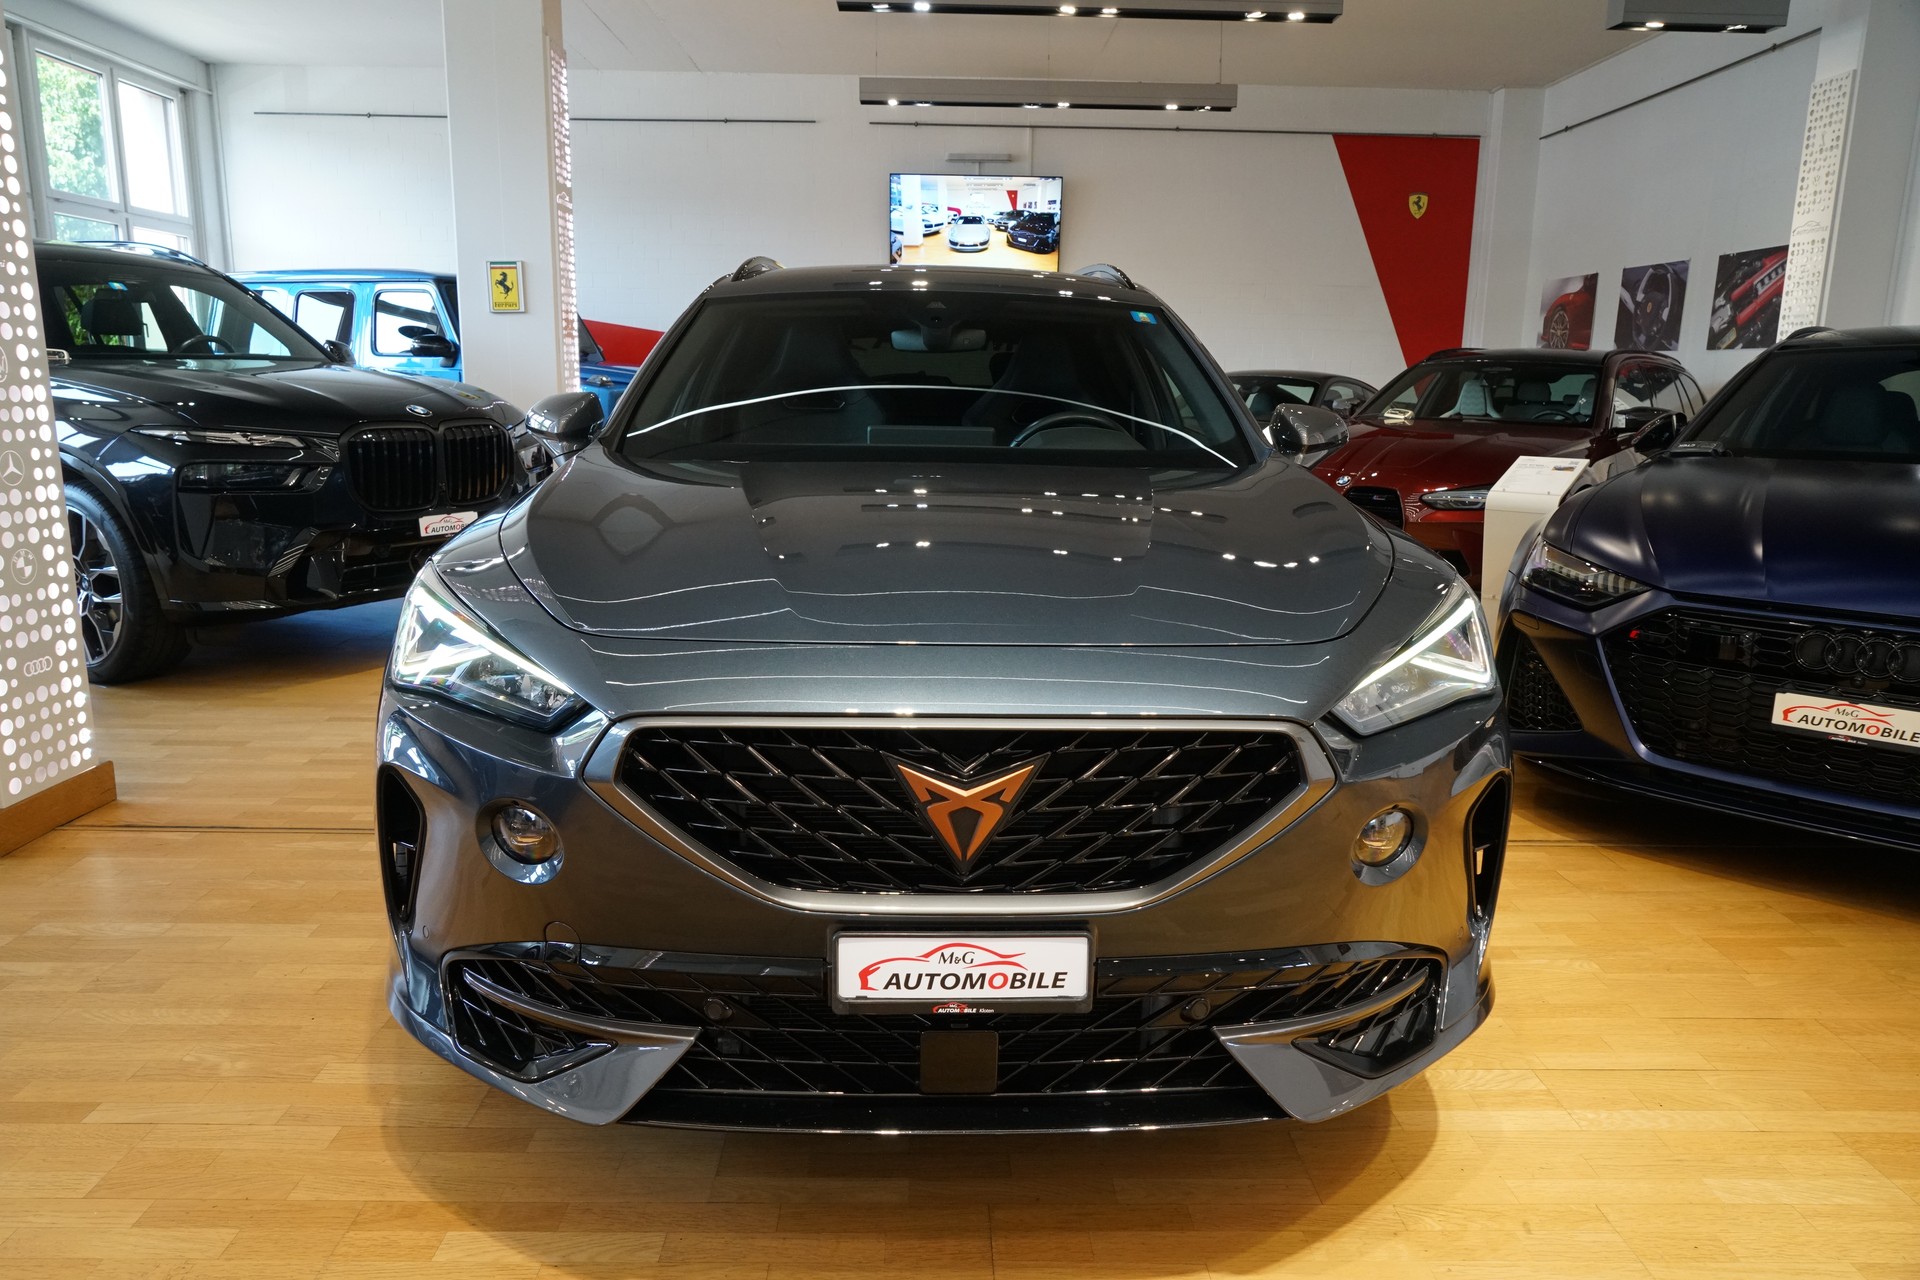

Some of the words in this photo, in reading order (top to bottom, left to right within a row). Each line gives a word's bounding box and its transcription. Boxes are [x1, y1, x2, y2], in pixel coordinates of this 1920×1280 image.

[1835, 708, 1860, 718] M&G
[1797, 714, 1920, 742] AUTOMOBILE
[938, 951, 975, 965] M&G
[883, 971, 1068, 990] AUTOMOBILE
